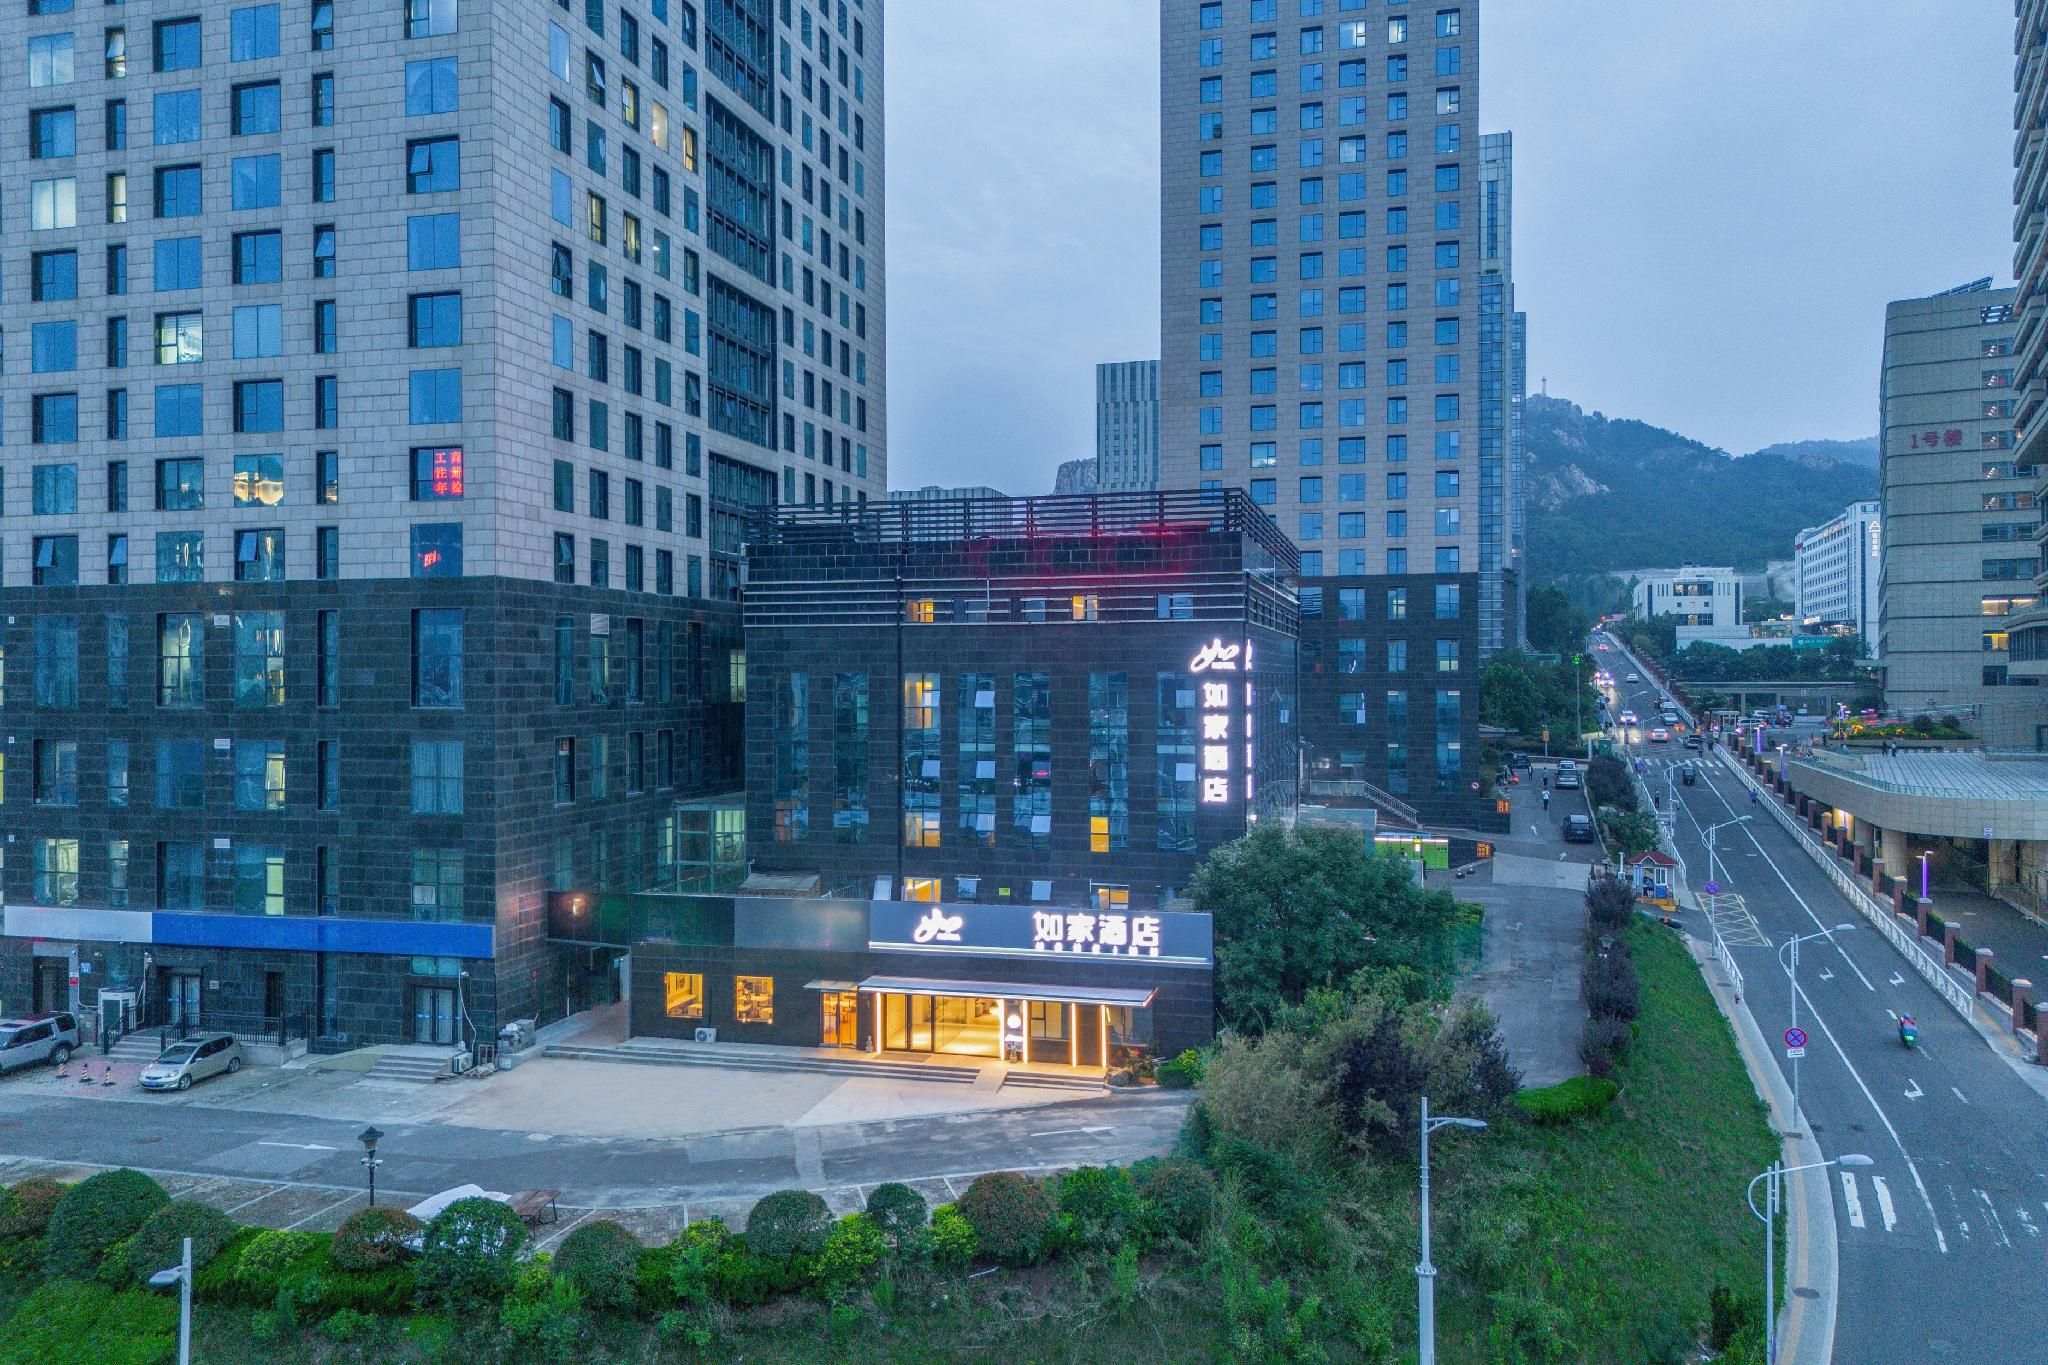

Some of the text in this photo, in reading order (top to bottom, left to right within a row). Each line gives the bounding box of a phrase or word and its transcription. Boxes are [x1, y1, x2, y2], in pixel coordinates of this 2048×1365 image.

[1203, 682, 1229, 803] 如家酒店
[1033, 911, 1160, 947] 如家酒店
